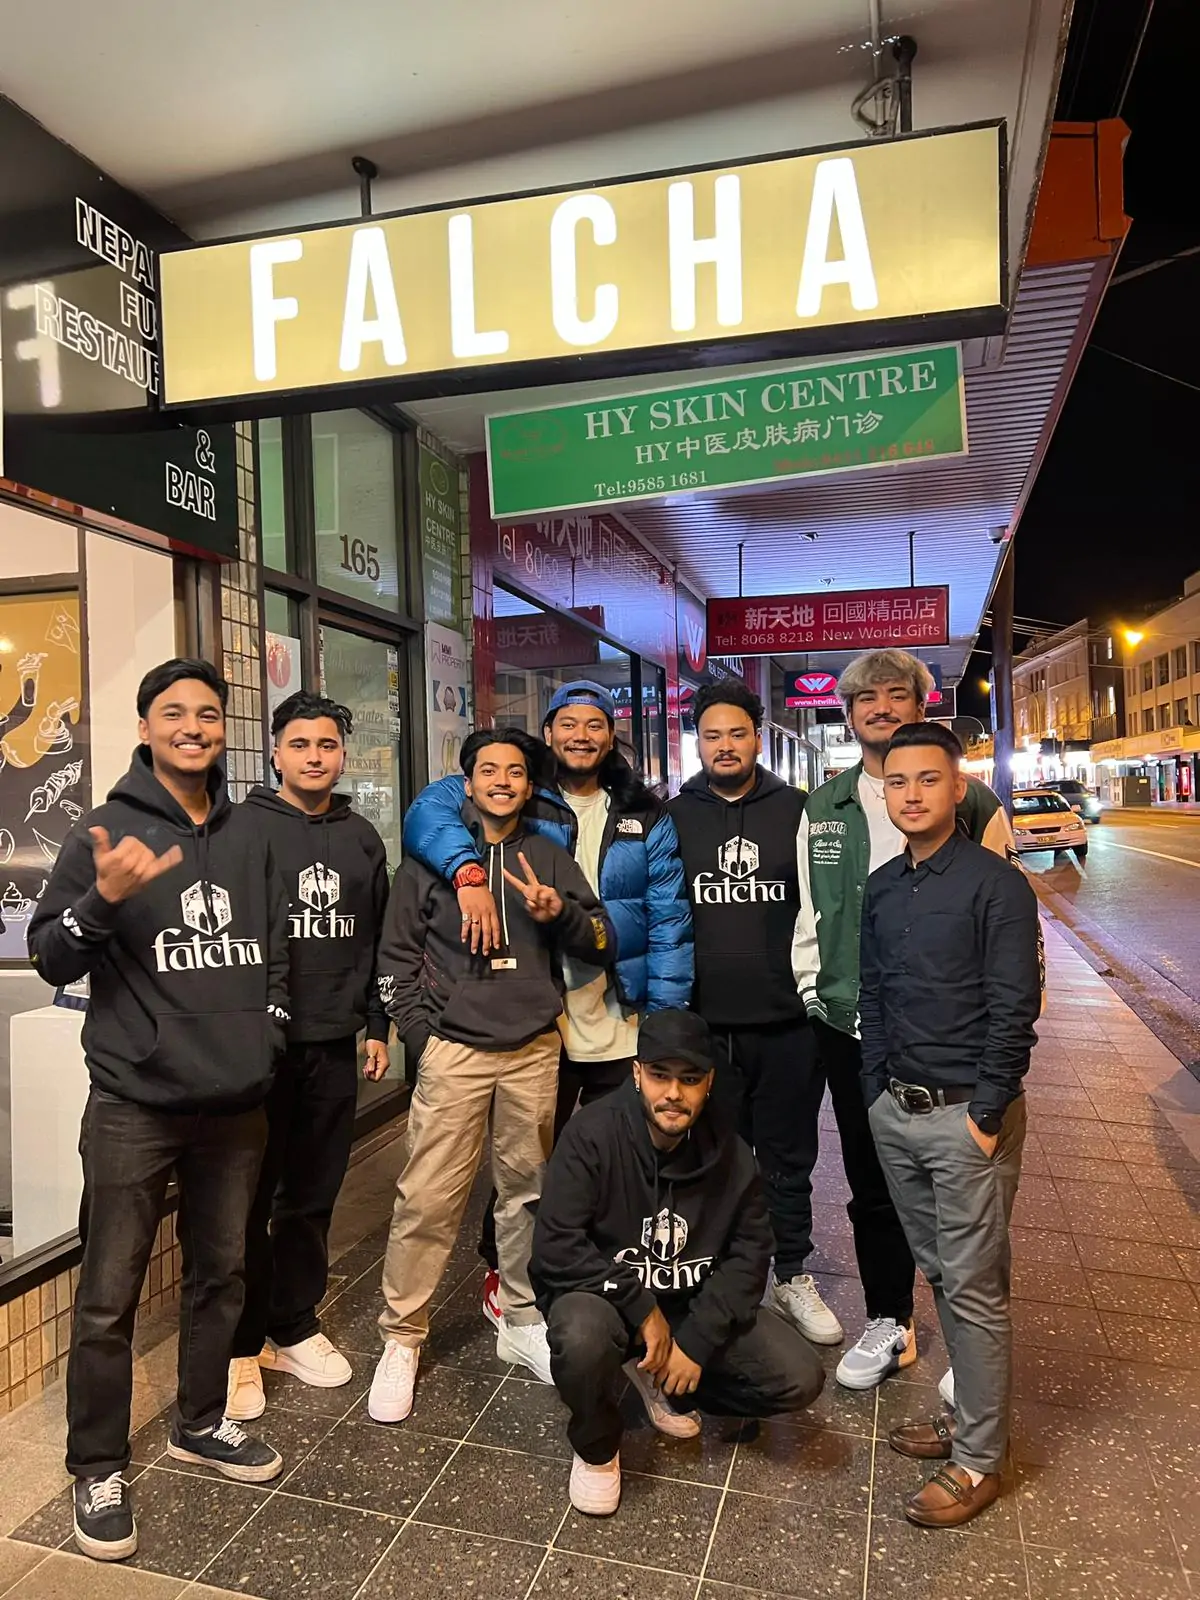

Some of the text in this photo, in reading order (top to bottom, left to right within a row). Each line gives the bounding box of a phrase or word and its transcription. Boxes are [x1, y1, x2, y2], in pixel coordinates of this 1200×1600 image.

[76, 197, 154, 291] NEPA
[250, 157, 880, 382] FALCHA
[120, 281, 157, 341] FU
[584, 360, 937, 440] HY SKIN CENTRE
[195, 430, 216, 474] &
[166, 462, 216, 521] BAR
[670, 470, 709, 487] 1681
[425, 516, 456, 548] CENTRE
[339, 534, 380, 582] 165
[715, 622, 941, 647] Tel: 8068 8218 New World Gifts
[745, 605, 815, 631] 新天地
[692, 872, 786, 905] falcha
[287, 903, 356, 938] alcha
[151, 927, 264, 973] falcha
